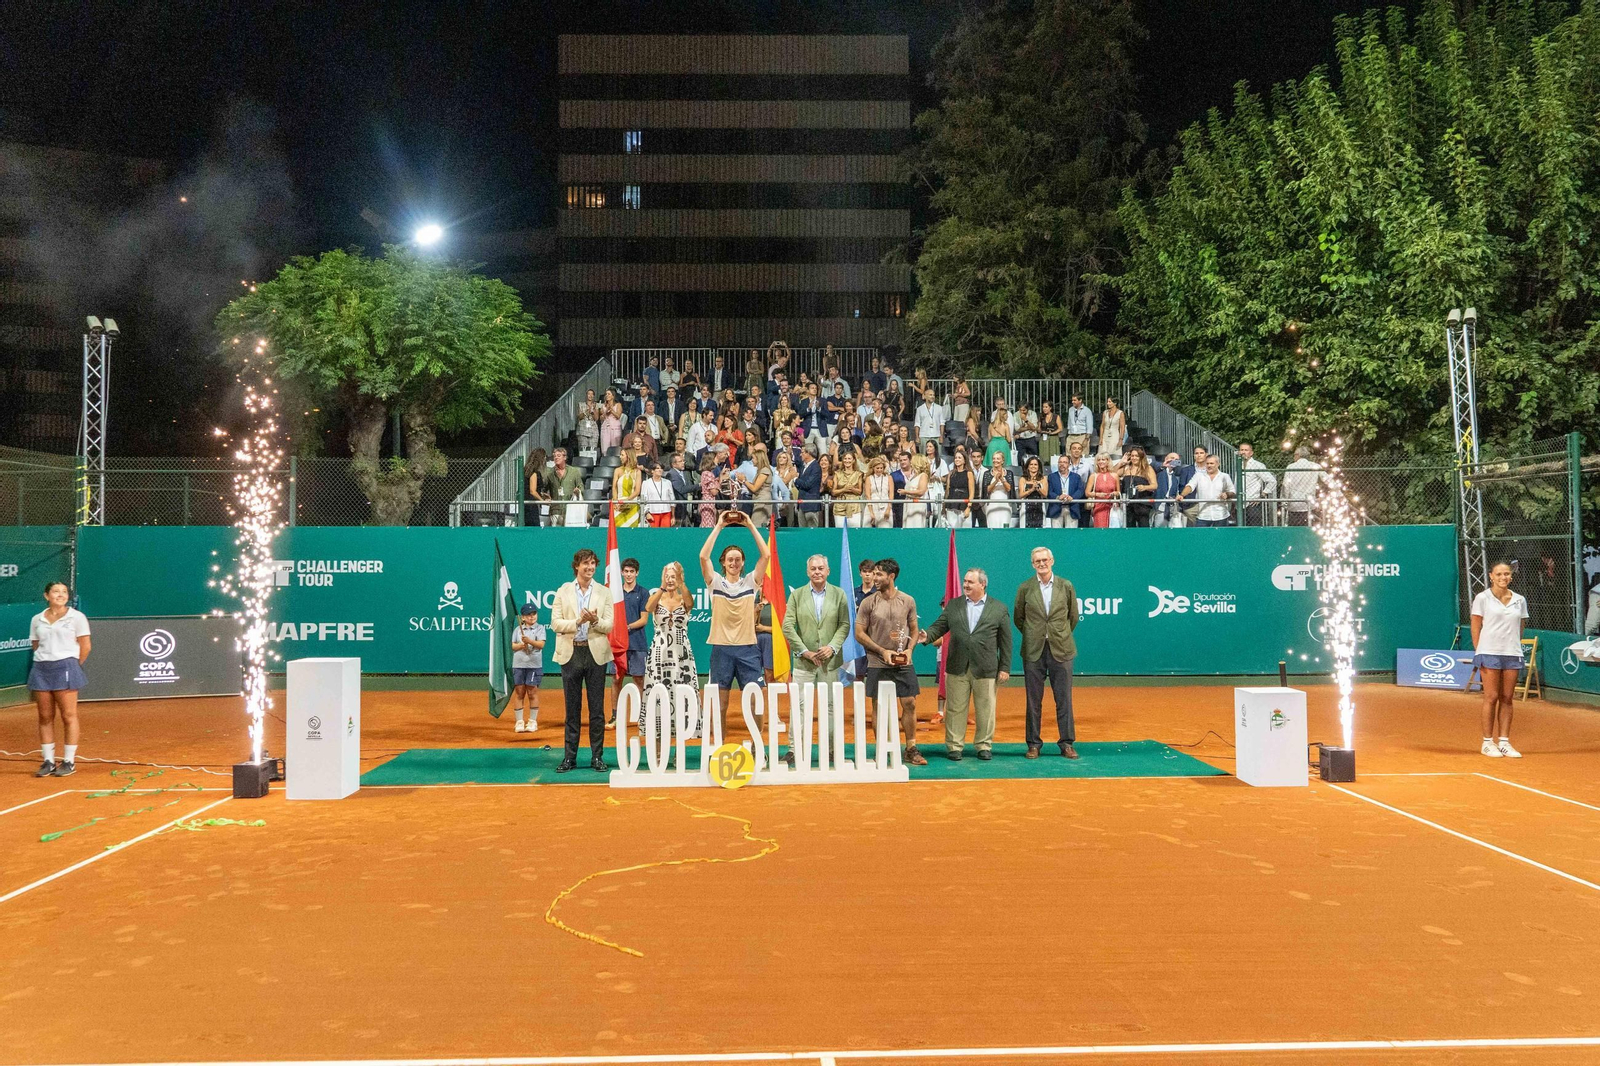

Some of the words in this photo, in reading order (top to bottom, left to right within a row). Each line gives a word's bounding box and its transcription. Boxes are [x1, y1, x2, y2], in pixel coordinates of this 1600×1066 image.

[297, 560, 384, 573] CHALLENGER
[297, 573, 334, 587] TOUR
[1193, 593, 1236, 602] Diputación
[1193, 602, 1236, 613] Sevilla
[409, 616, 491, 631] SCALPERS
[139, 661, 175, 671] COPA
[1420, 672, 1455, 680] COPA
[616, 682, 723, 774] COPA
[741, 680, 902, 773] SEVILLA
[718, 750, 747, 781] 62
